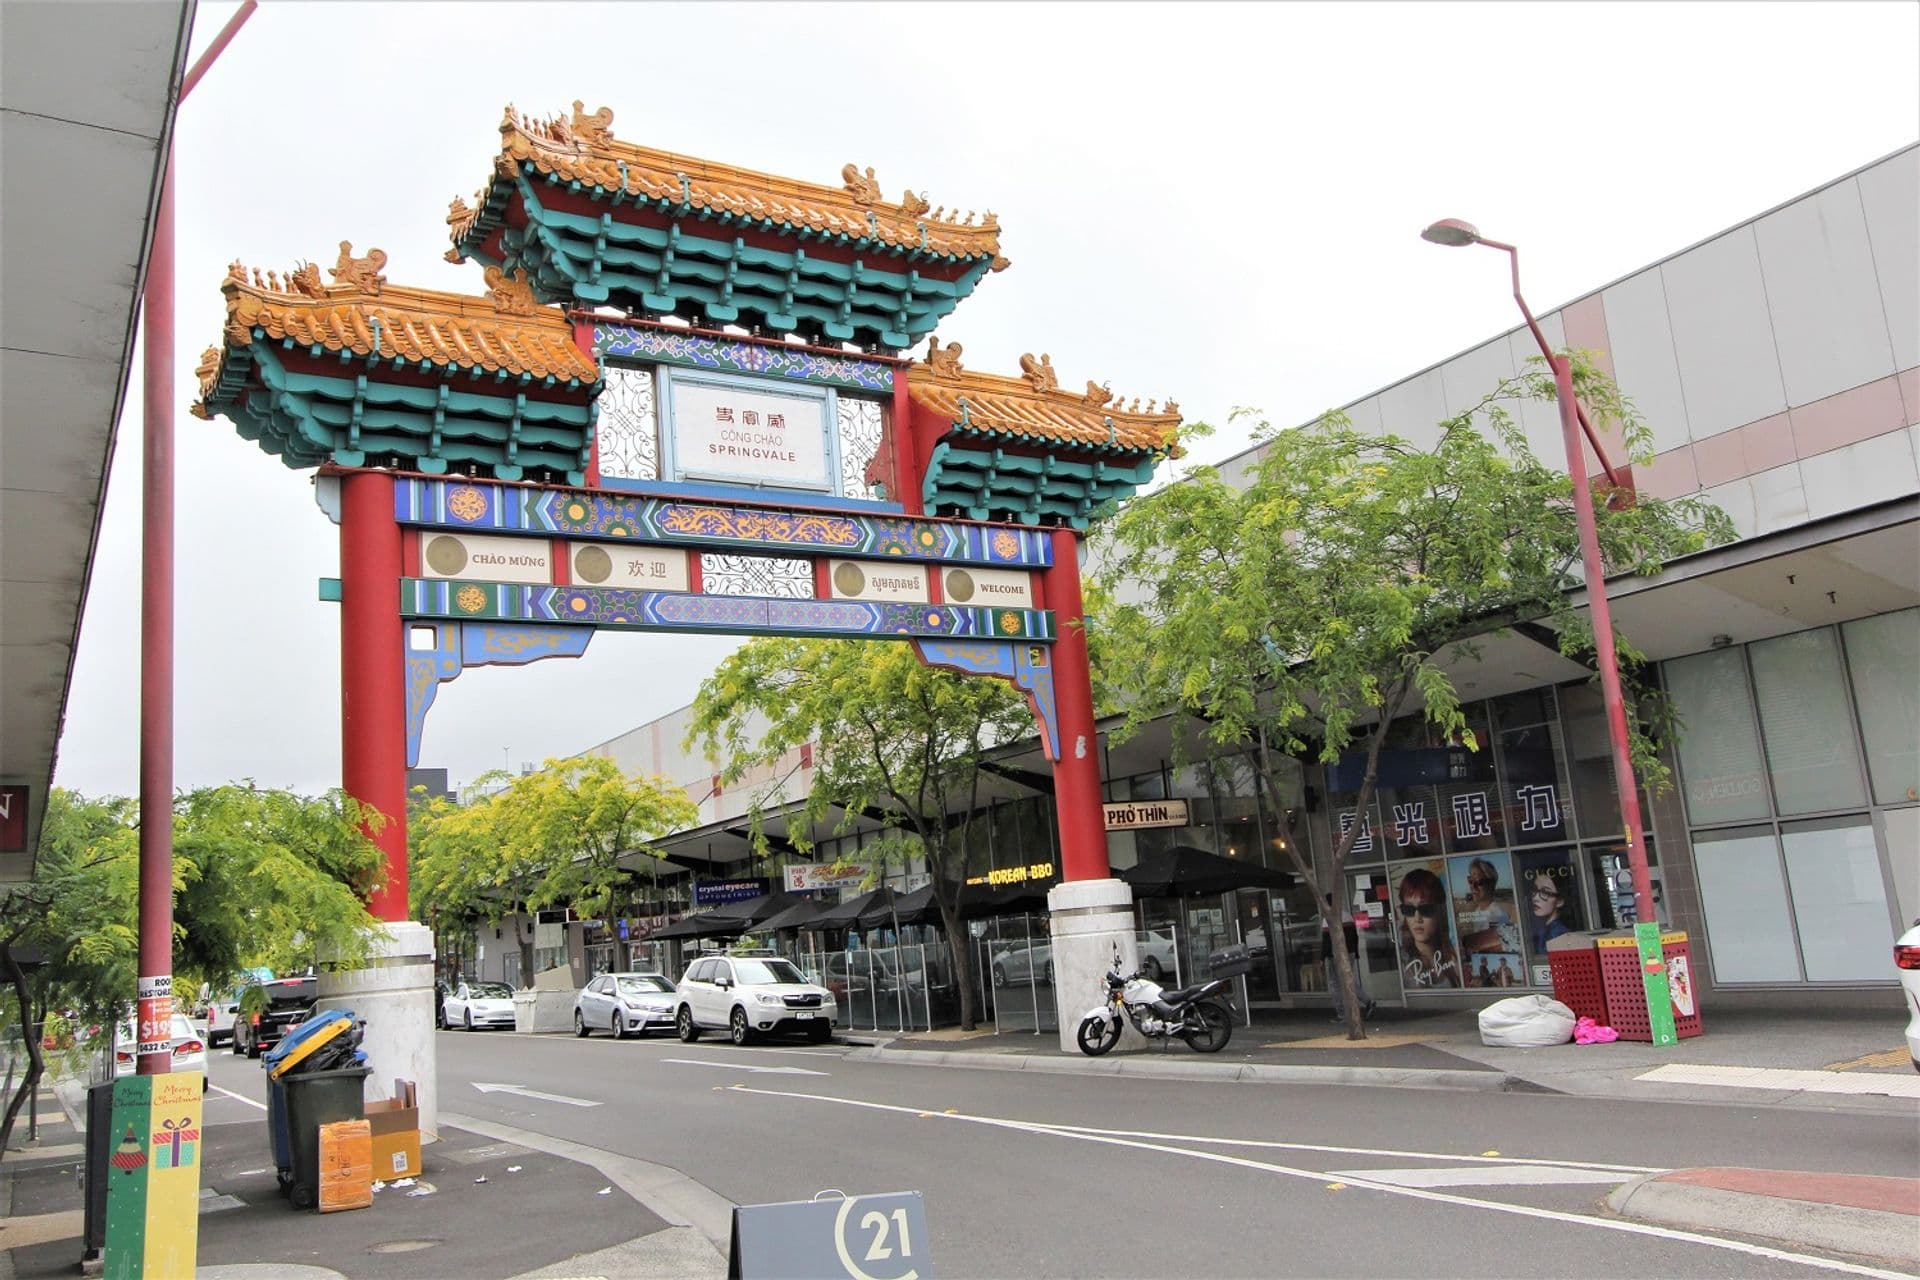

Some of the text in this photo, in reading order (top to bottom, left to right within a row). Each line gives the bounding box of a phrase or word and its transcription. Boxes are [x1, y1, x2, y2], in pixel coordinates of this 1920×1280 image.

[709, 444, 796, 462] SPRINGVALE
[472, 553, 506, 565] CHÀO
[627, 560, 667, 578] 欢迎
[980, 584, 1024, 595] WELCOME
[988, 866, 1027, 885] KOREAN
[1030, 863, 1053, 879] BBQ
[1524, 867, 1575, 880] GUCCI
[164, 1085, 192, 1095] Merry
[153, 1095, 201, 1106] Christmas
